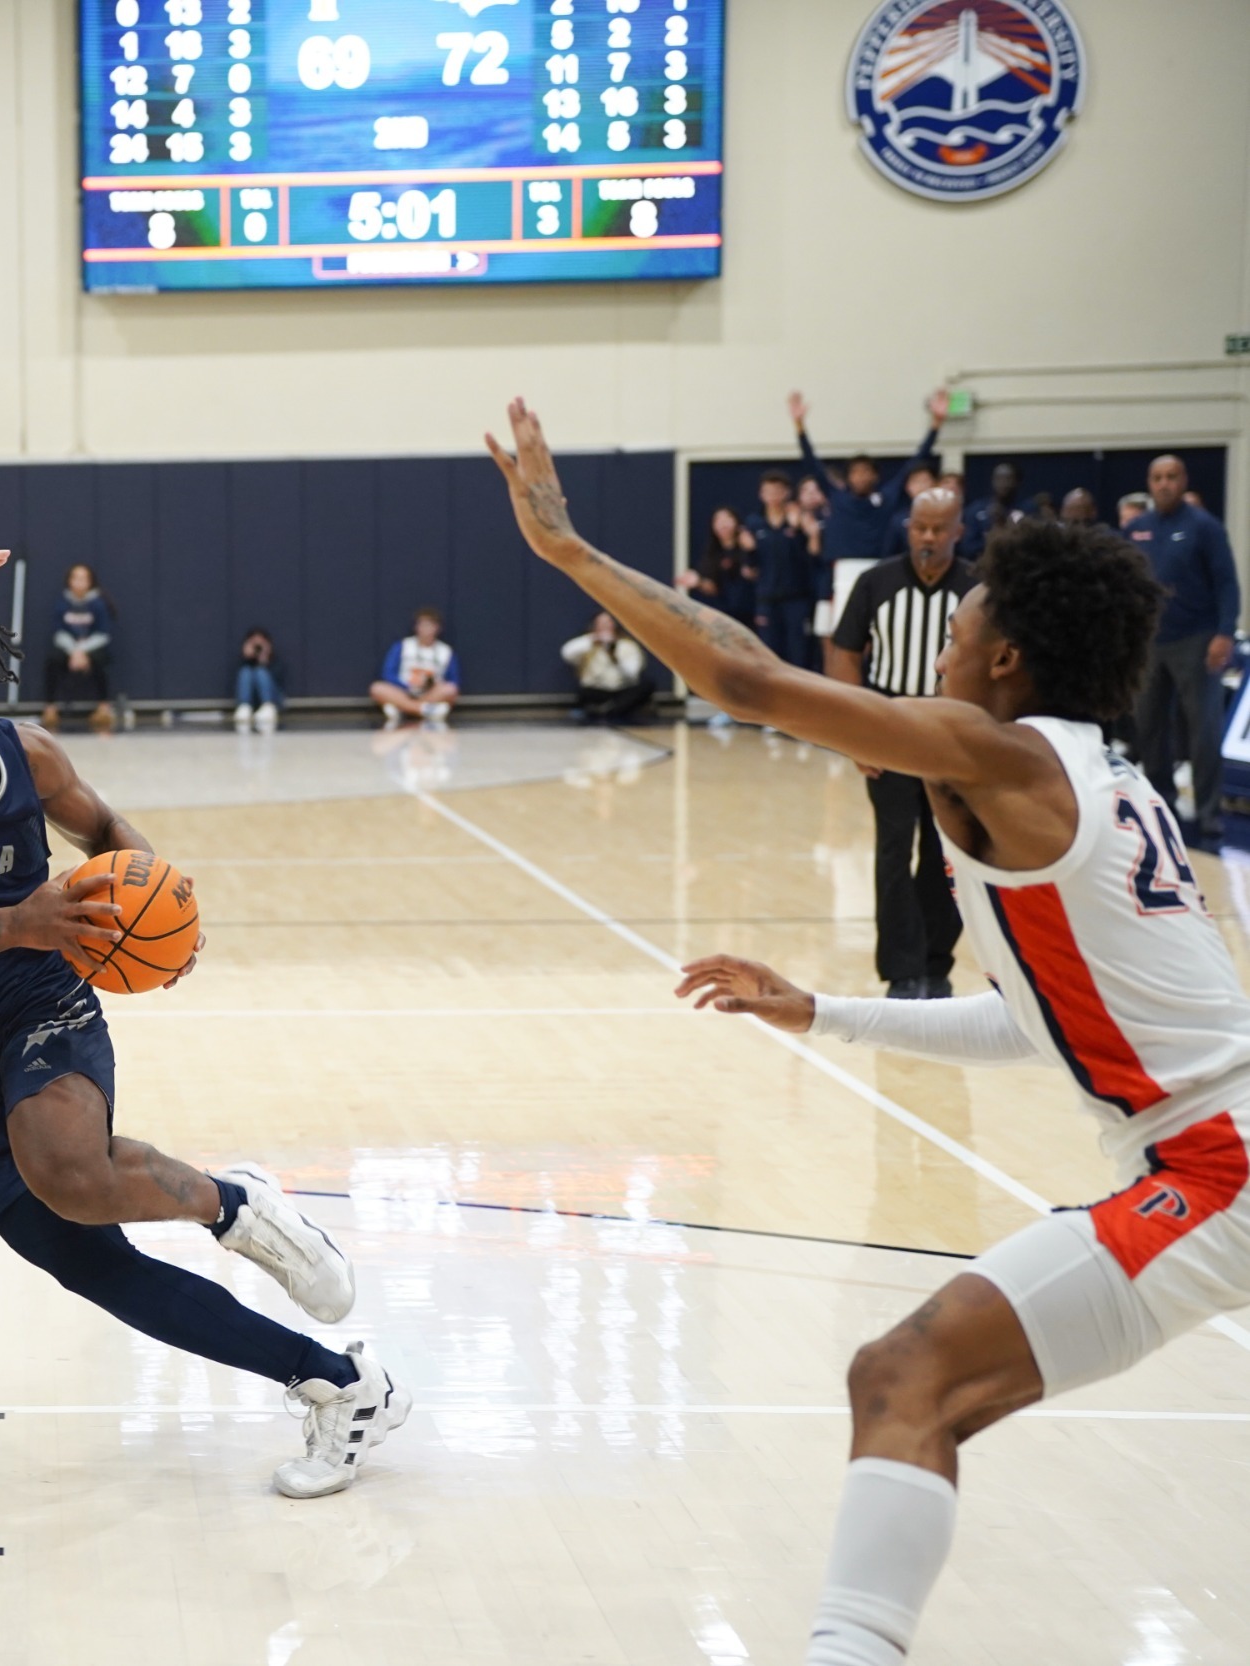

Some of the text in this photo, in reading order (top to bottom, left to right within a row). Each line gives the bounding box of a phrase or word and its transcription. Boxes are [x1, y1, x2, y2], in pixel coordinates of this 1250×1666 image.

[119, 31, 139, 61] 1
[228, 29, 251, 59] 3
[607, 17, 631, 48] 2
[664, 15, 688, 46] 2
[297, 34, 371, 90] 69
[436, 30, 509, 86] 72
[545, 50, 688, 84] 11 7 3
[109, 63, 251, 95] 12 7 0
[110, 97, 252, 129] 14 4 3
[664, 85, 687, 115] 3
[229, 131, 252, 161] 3
[542, 122, 581, 153] 14
[663, 119, 687, 149] 3
[349, 189, 456, 241] 5:01
[536, 204, 560, 235] 3
[1114, 790, 1214, 917] 24
[1129, 1181, 1191, 1221] P
